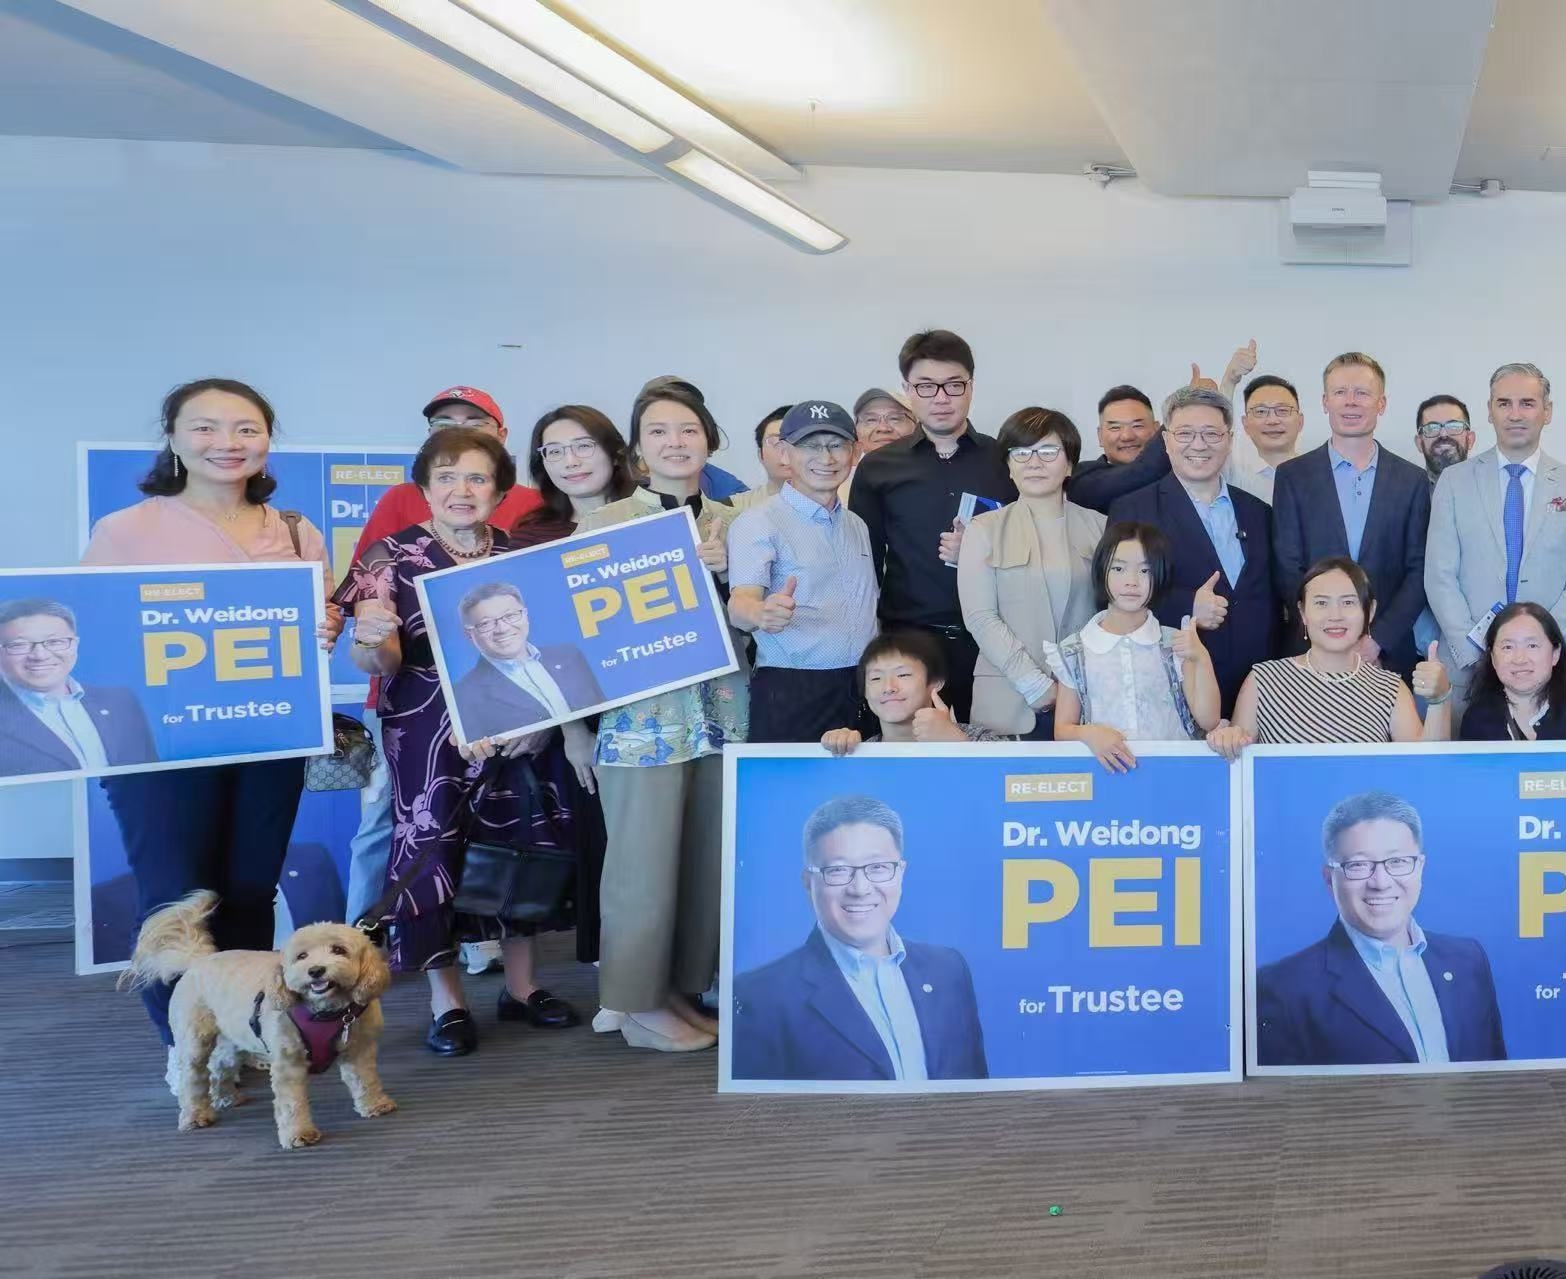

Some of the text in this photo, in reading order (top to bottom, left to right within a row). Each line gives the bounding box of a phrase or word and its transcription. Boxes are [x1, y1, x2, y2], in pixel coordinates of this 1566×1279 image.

[335, 470, 401, 480] RE-ELECT
[331, 500, 370, 518] Dr.
[566, 547, 686, 589] Dr. Weidong
[571, 563, 699, 639] PEI
[141, 606, 298, 625] Dr. Weidong
[143, 625, 302, 687] PEI
[601, 631, 698, 668] for Trustee
[162, 701, 292, 724] for Trustee
[1011, 780, 1089, 795] RE-ELECT
[1003, 819, 1201, 850] Dr. Weidong
[1519, 815, 1562, 840] Dr.
[1002, 857, 1201, 949] PEI
[1019, 985, 1184, 1014] for Trustee
[1535, 984, 1560, 999] for
